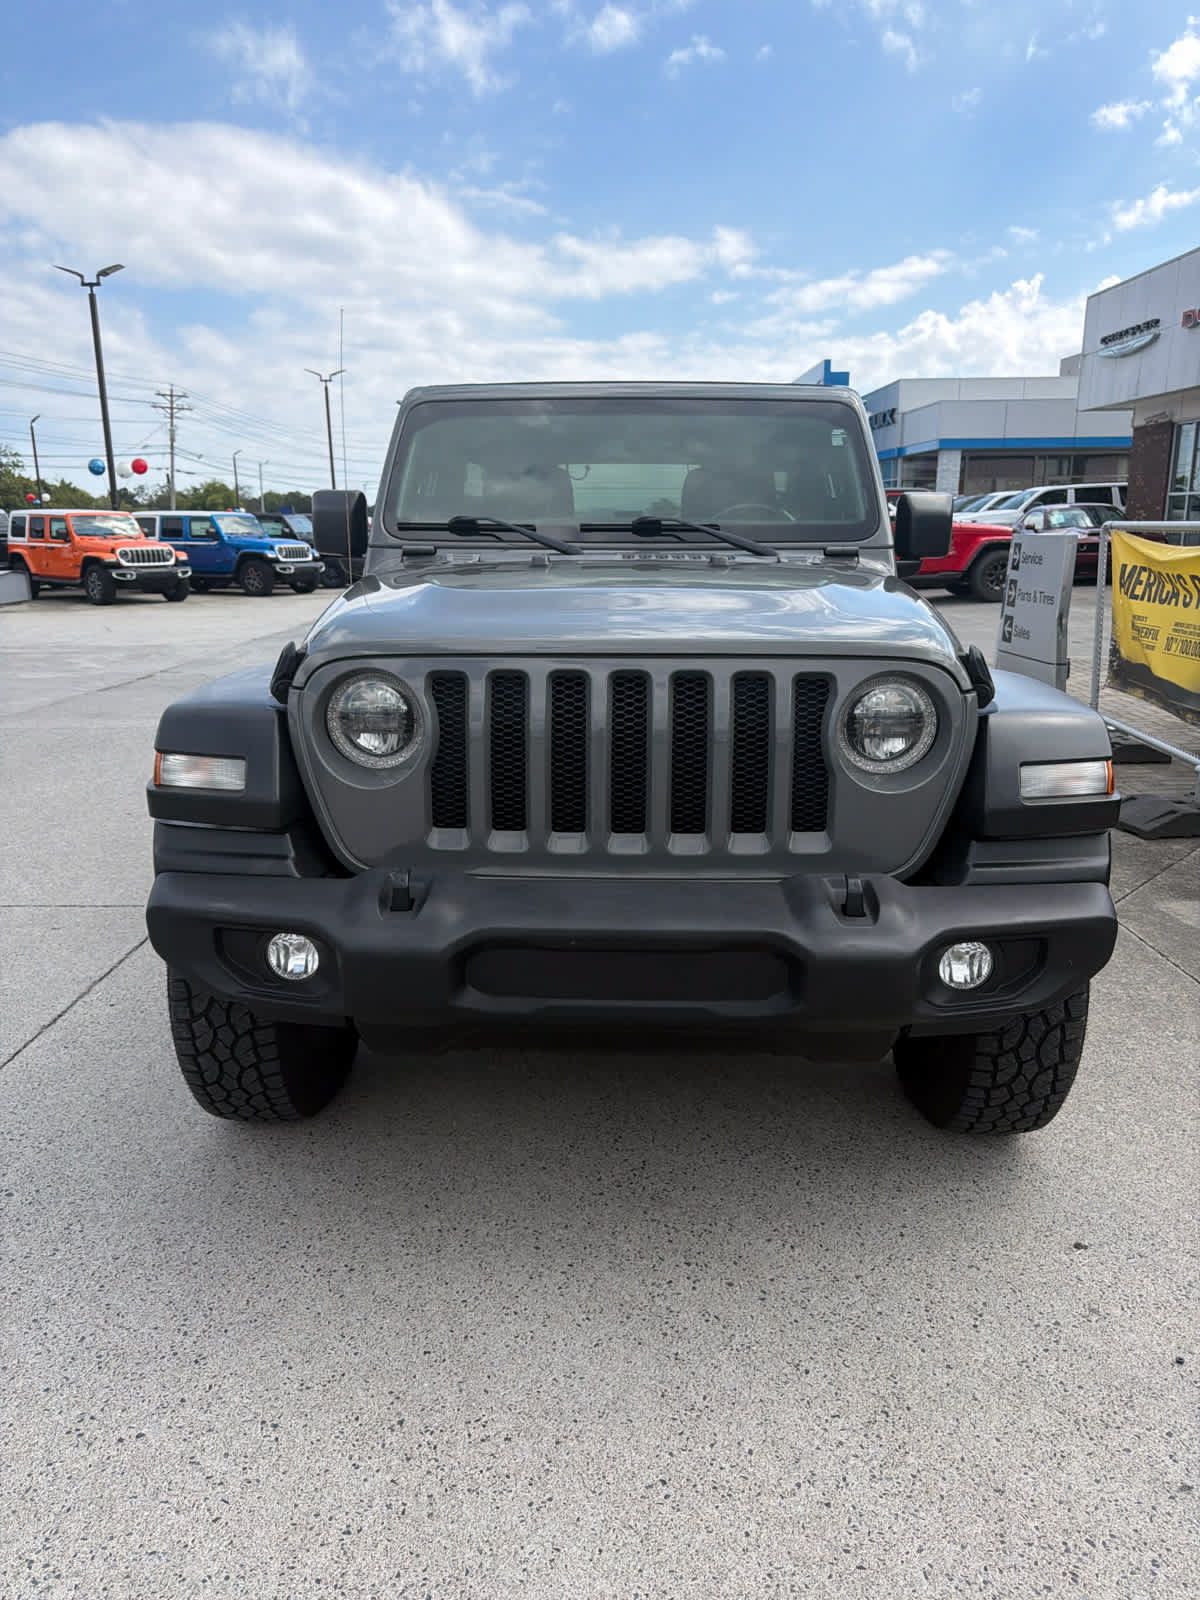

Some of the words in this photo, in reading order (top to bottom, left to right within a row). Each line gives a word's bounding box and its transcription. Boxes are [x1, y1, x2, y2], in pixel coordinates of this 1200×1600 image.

[1021, 551, 1043, 565] Service
[1016, 588, 1032, 603] Parts
[1032, 590, 1038, 603] &
[1039, 591, 1055, 606] Tires
[1013, 624, 1031, 640] Sales
